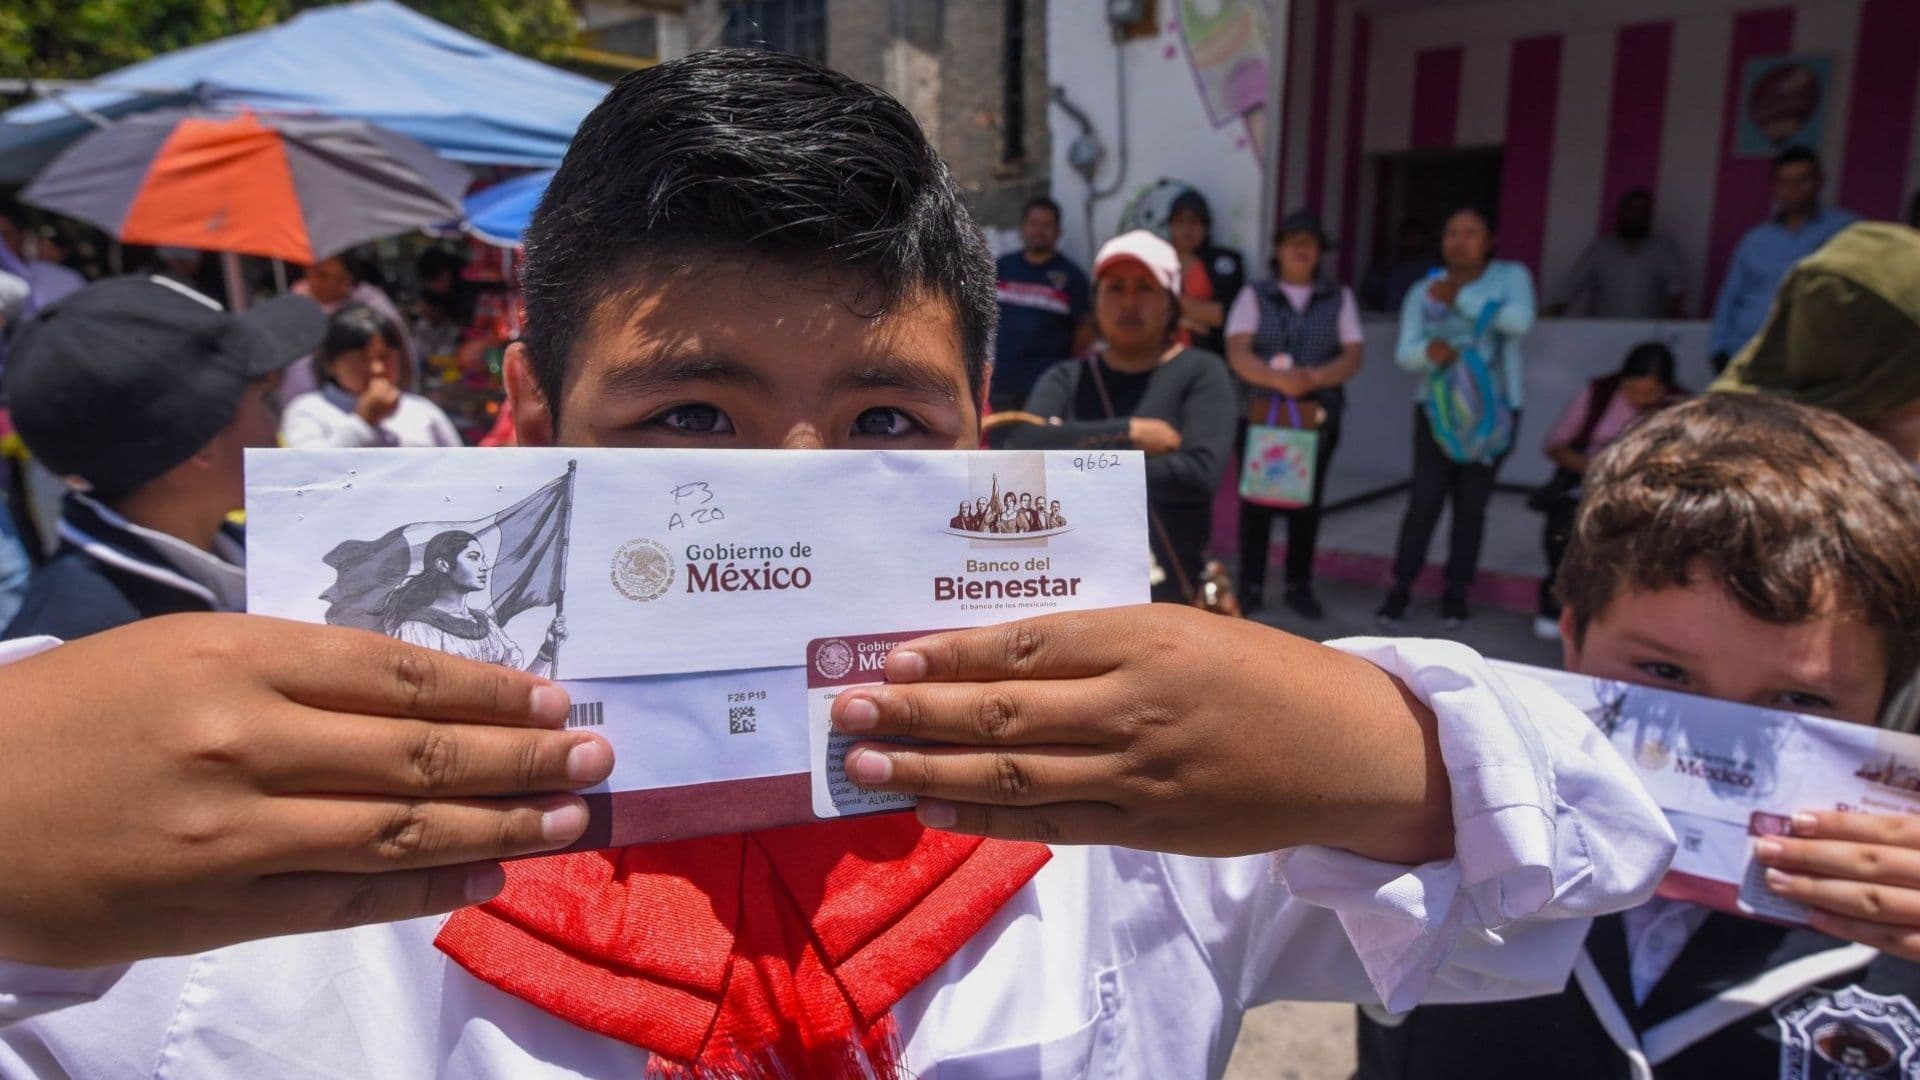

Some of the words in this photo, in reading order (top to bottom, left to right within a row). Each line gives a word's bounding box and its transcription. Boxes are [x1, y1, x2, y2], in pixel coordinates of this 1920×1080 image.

[1073, 454, 1121, 472] 9662
[668, 512, 684, 531] A
[690, 507, 725, 524] 20
[685, 543, 783, 561] Gobierno
[789, 541, 812, 558] de
[966, 558, 1020, 574] Banco
[1024, 557, 1051, 571] del
[685, 561, 812, 593] México
[934, 574, 1081, 601] Bienestar
[969, 602, 993, 611] banco
[994, 602, 1004, 610] de
[1018, 600, 1057, 609] mexicanos
[857, 640, 904, 652] Gobier
[728, 692, 746, 702] F26
[748, 691, 767, 700] P19
[868, 793, 906, 806] ALVARO
